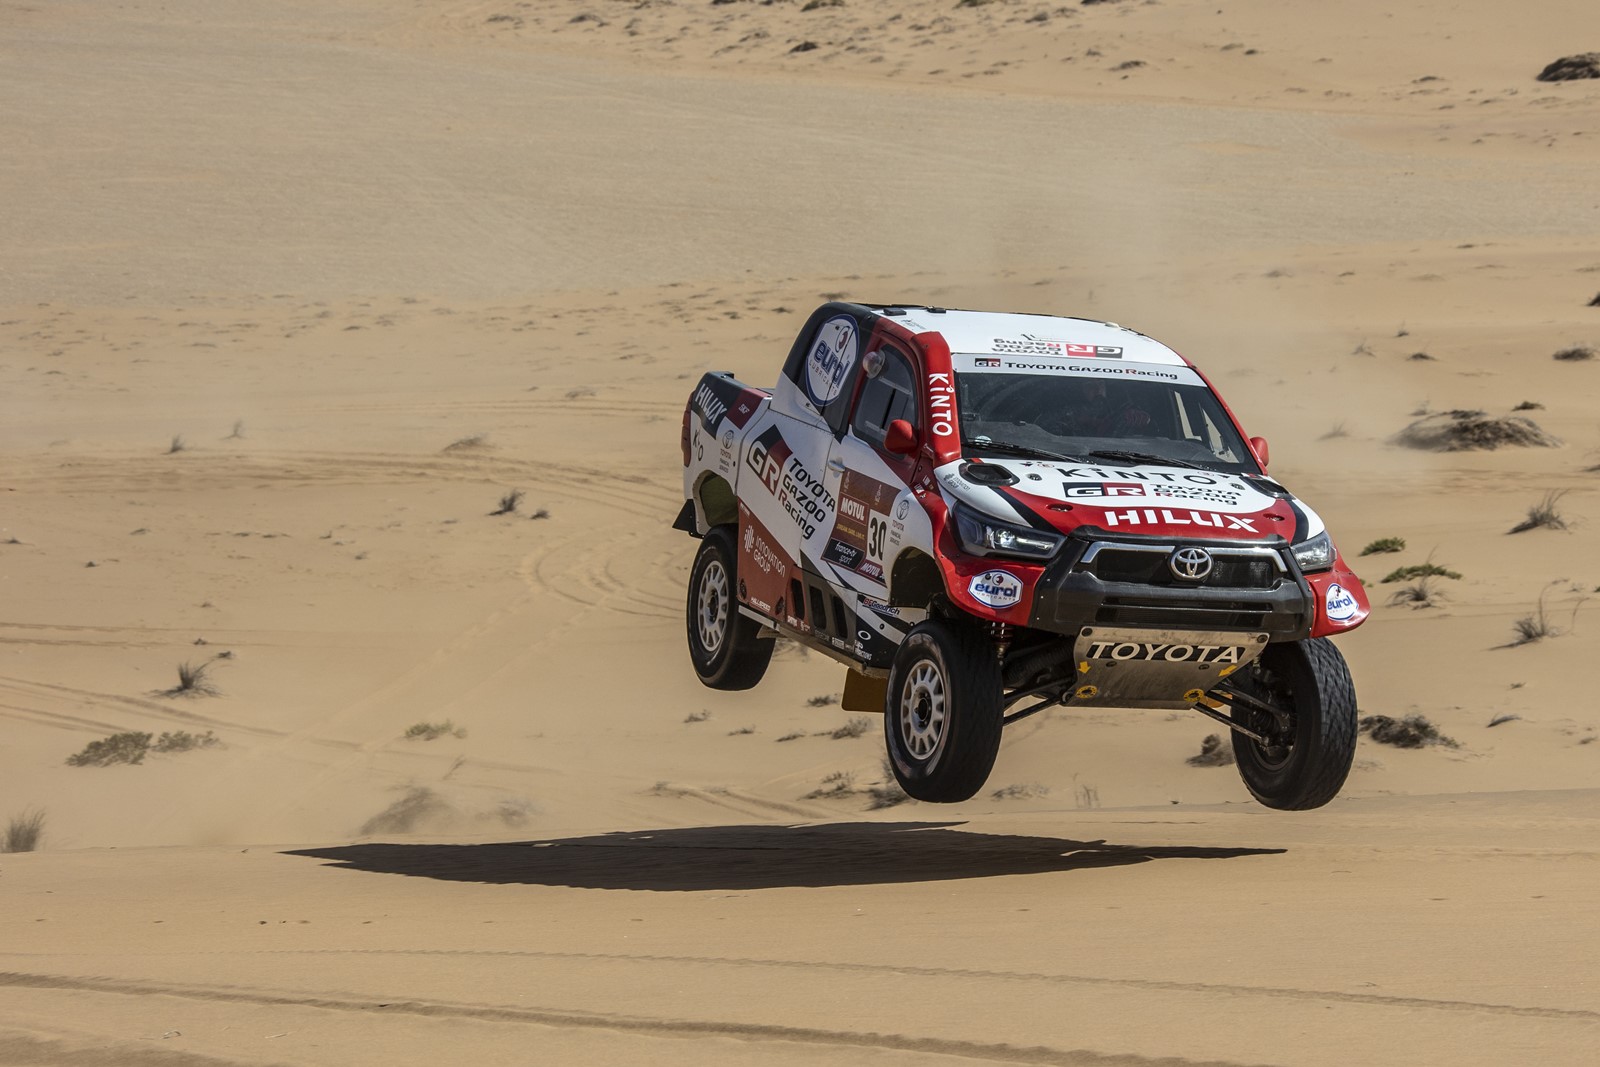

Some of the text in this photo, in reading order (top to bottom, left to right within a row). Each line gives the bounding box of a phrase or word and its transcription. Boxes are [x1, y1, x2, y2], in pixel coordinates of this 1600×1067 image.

[975, 359, 1178, 380] GR TOYOTA GAZOO Racing
[695, 383, 728, 425] HILUX
[748, 440, 781, 496] GR
[788, 457, 837, 512] TOYOTA
[1067, 485, 1145, 498] GR
[1150, 483, 1241, 496] TOYOTA
[782, 474, 826, 523] GAZOO
[841, 498, 866, 521] MOTUL
[1155, 492, 1238, 506] Racing
[778, 488, 816, 540] Racing
[1104, 509, 1259, 533] HILUX
[869, 517, 887, 561] 30
[753, 549, 771, 574] GROUP
[860, 563, 881, 577] MOTUL
[975, 583, 1018, 598] eurol
[1327, 595, 1353, 610] eurol
[1092, 641, 1239, 664] TOYOTA
